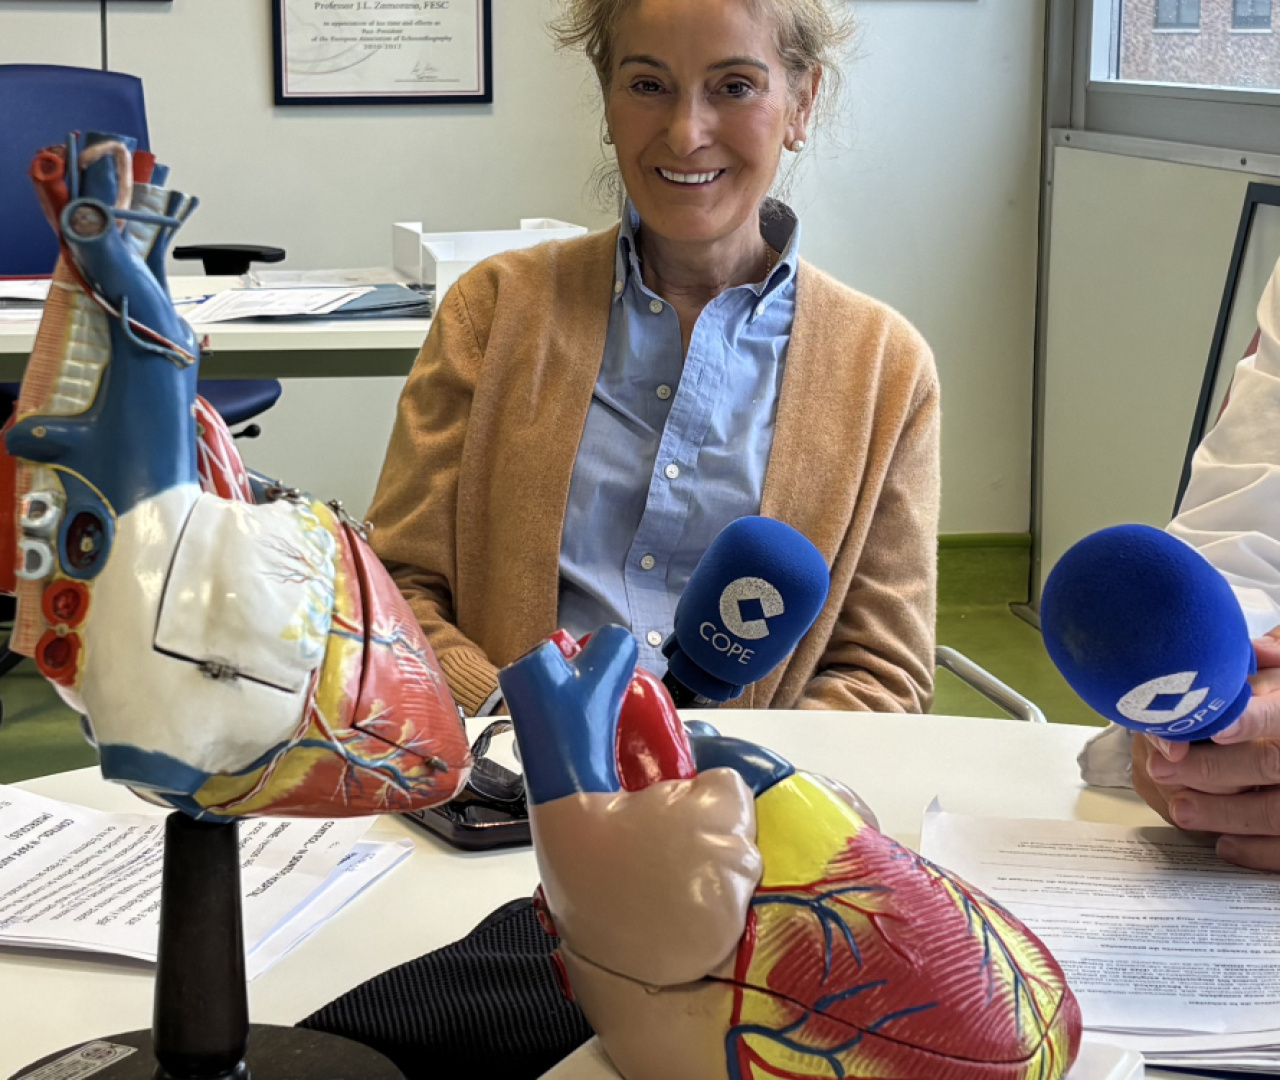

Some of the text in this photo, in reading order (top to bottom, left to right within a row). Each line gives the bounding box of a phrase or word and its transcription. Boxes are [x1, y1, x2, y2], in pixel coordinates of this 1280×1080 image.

[314, 1, 450, 11] Professor J.L. Zamorano, FESC
[698, 620, 756, 665] COPE
[1144, 697, 1227, 737] COPE
